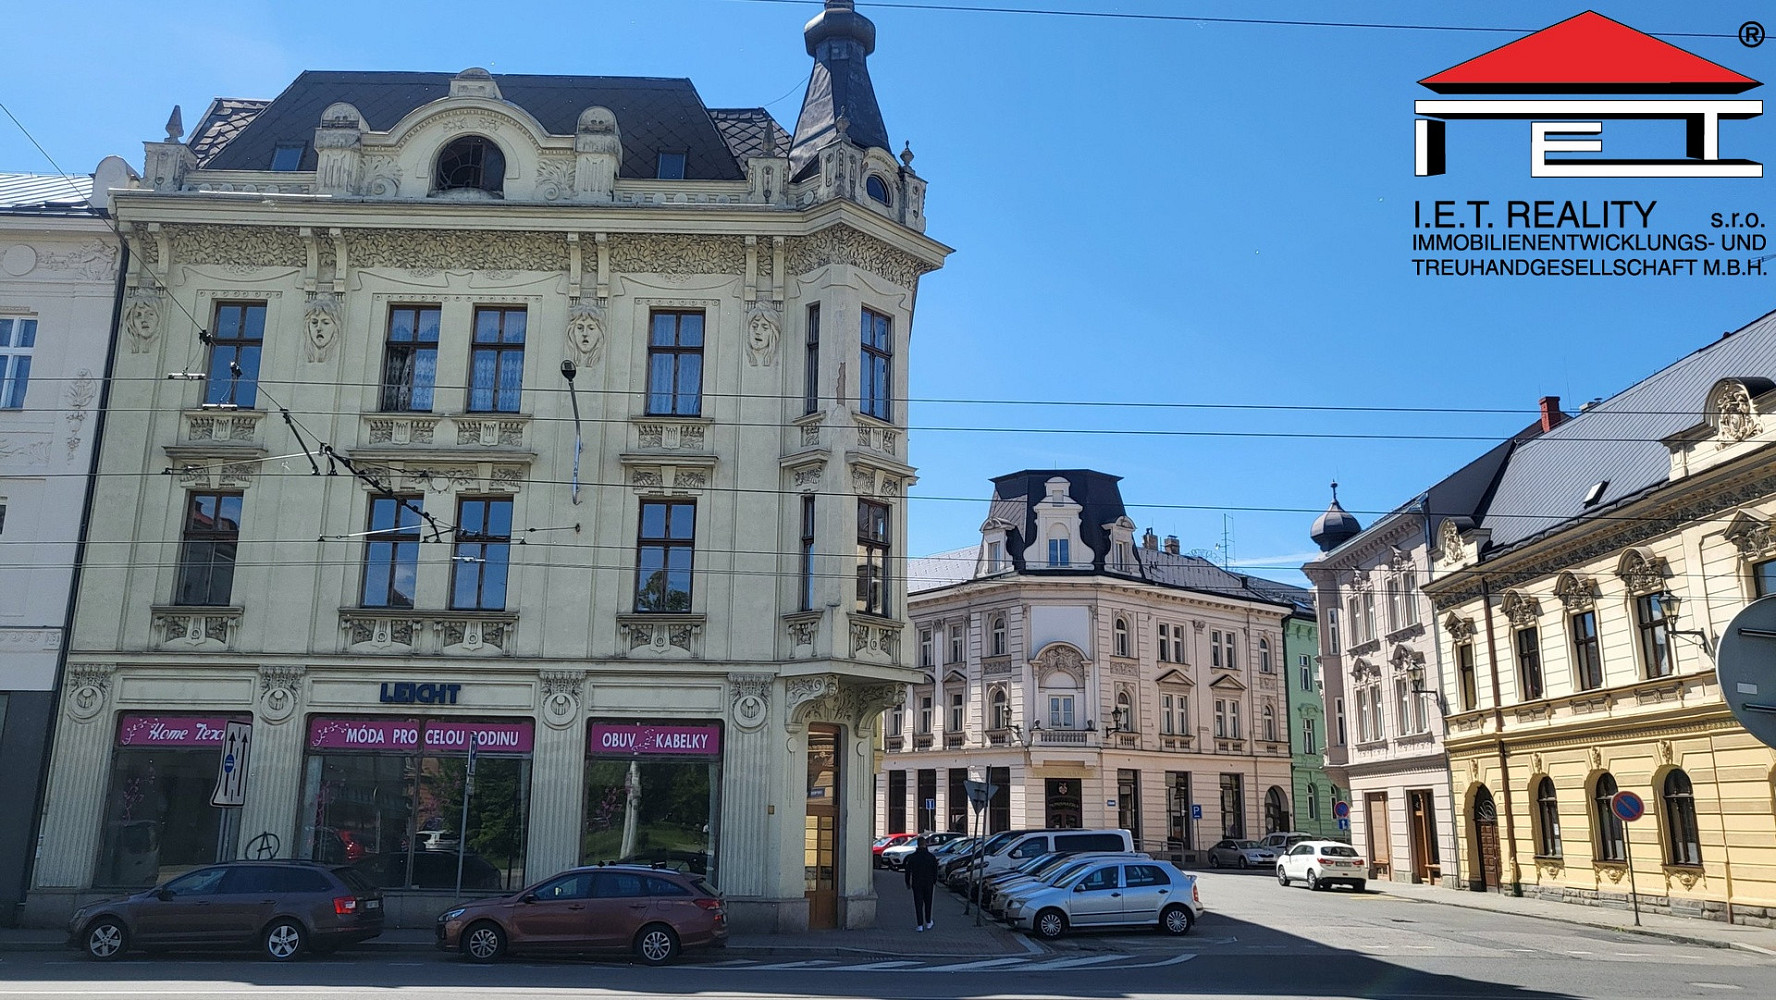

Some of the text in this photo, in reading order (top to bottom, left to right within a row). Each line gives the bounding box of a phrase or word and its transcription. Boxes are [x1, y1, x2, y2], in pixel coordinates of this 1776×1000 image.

[379, 683, 461, 704] LEICHT
[148, 722, 189, 740] Home
[346, 725, 385, 744] MÓDA
[393, 728, 418, 744] PRO
[425, 729, 465, 745] CELOU
[602, 732, 709, 749] OBUV KABELKY
